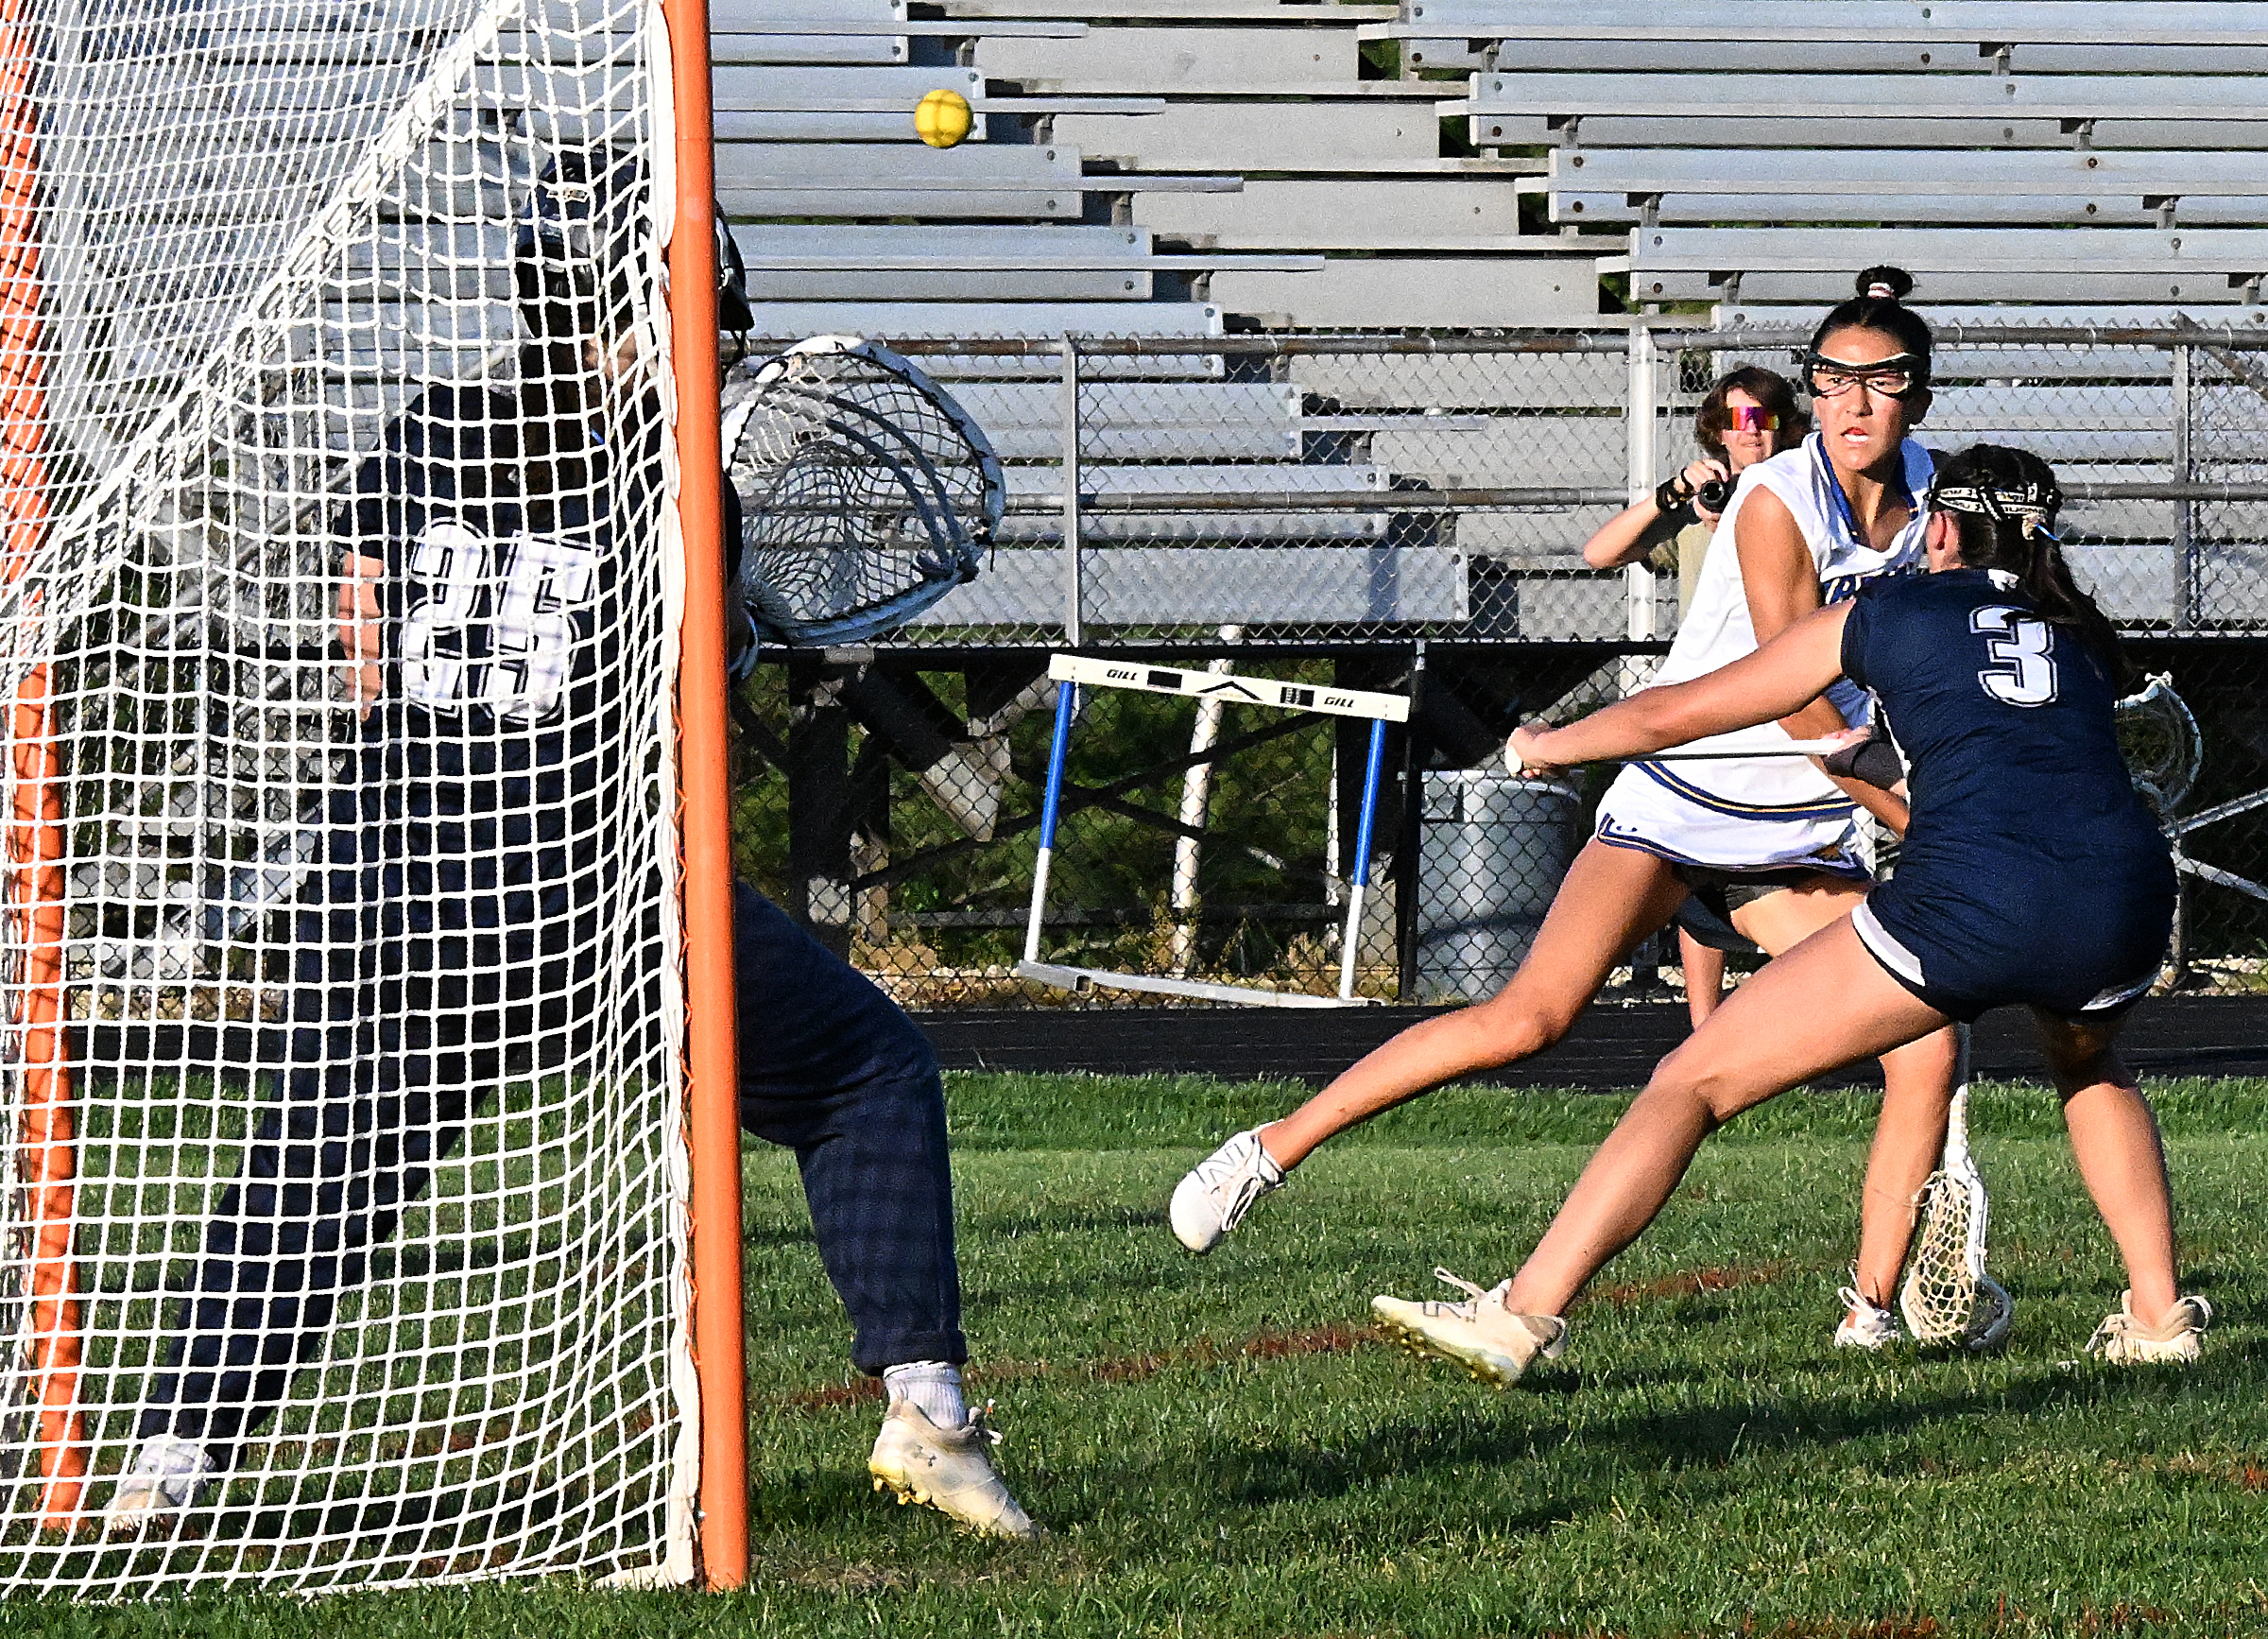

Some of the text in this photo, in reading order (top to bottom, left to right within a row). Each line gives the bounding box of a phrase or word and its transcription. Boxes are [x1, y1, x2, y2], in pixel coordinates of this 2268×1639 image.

[398, 516, 605, 726] 25
[1107, 668, 1137, 681] GILL
[1968, 604, 2058, 708] 3
[1324, 696, 1354, 708] GILL
